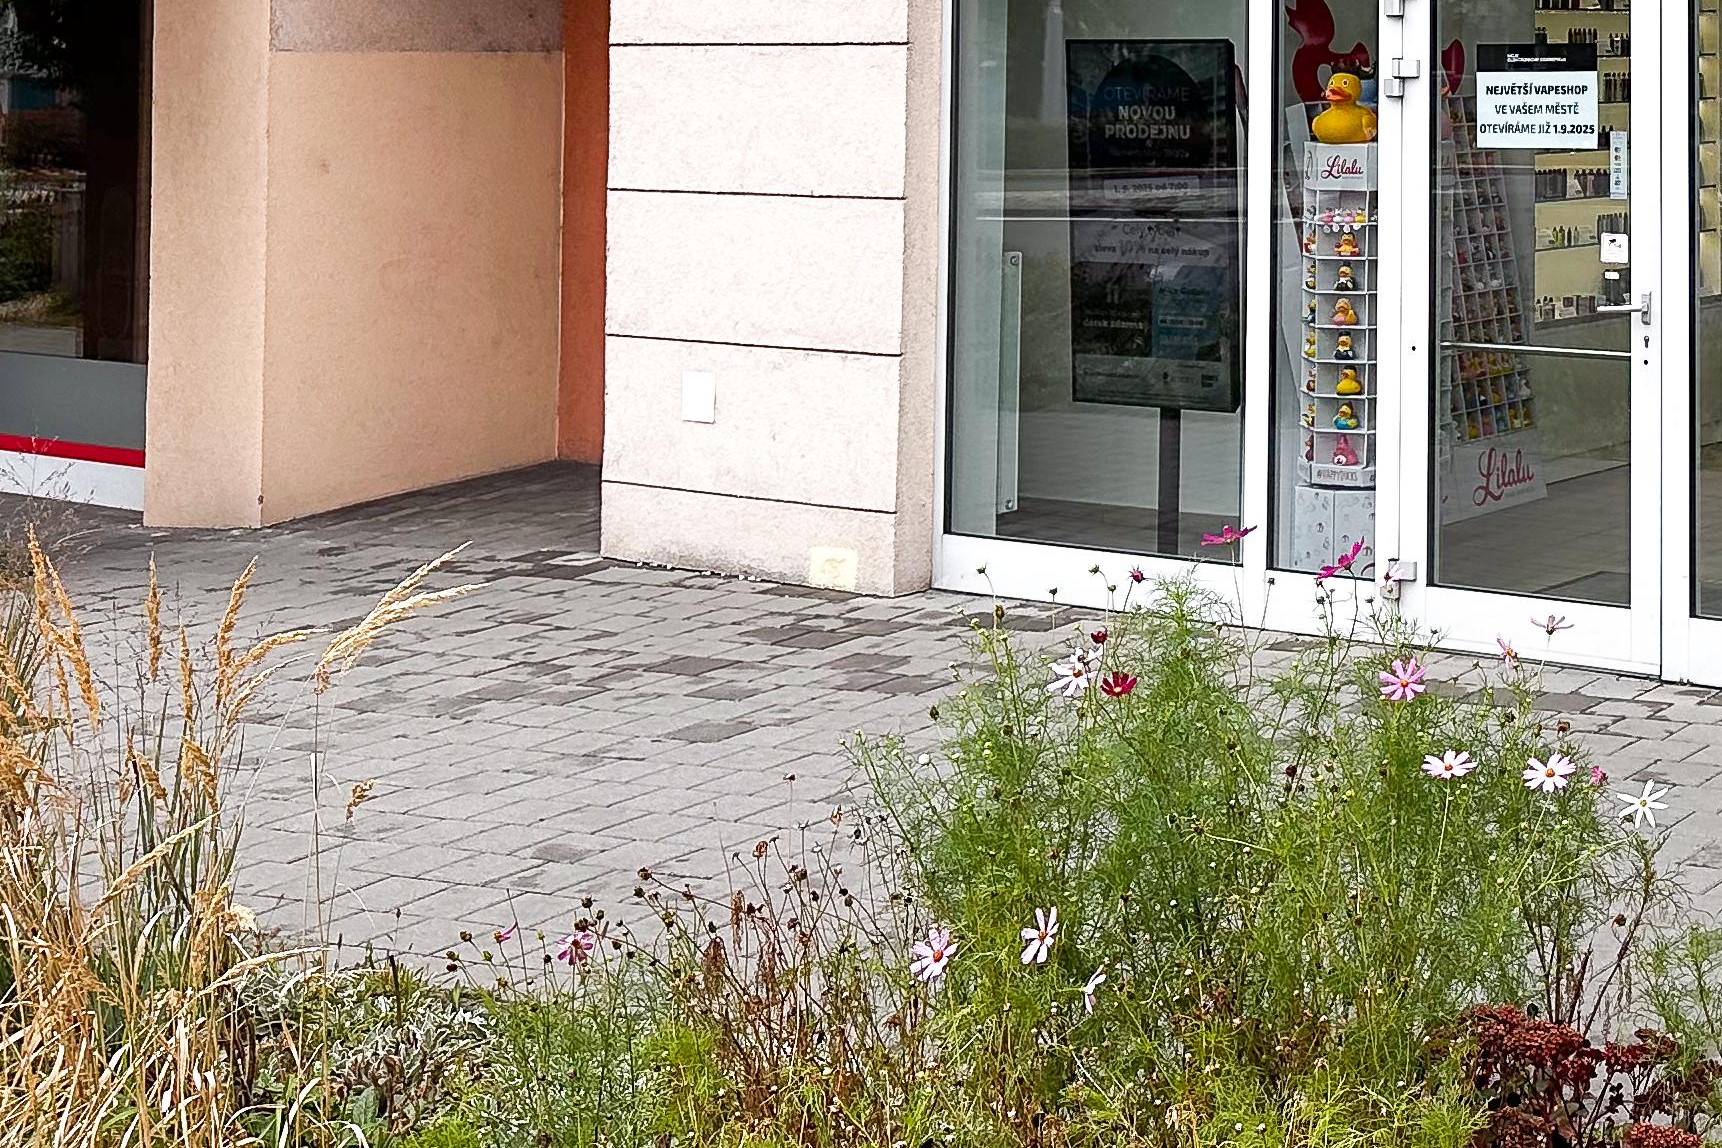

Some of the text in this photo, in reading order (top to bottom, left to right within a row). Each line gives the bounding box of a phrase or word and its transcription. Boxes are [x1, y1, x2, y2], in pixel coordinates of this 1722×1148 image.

[1485, 82, 1588, 95] NEJVĚTŠÍ VAPESHOP
[1118, 105, 1176, 120] NOVOU
[1494, 101, 1580, 115] VE VAŠEM MĚSTĚ
[1104, 124, 1191, 140] PRODEJNU
[1479, 120, 1536, 134] OTEVÍRÁME
[1552, 124, 1595, 135] 1.9.2025
[1320, 155, 1364, 179] Lilalu
[1472, 447, 1535, 507] Lilalu
